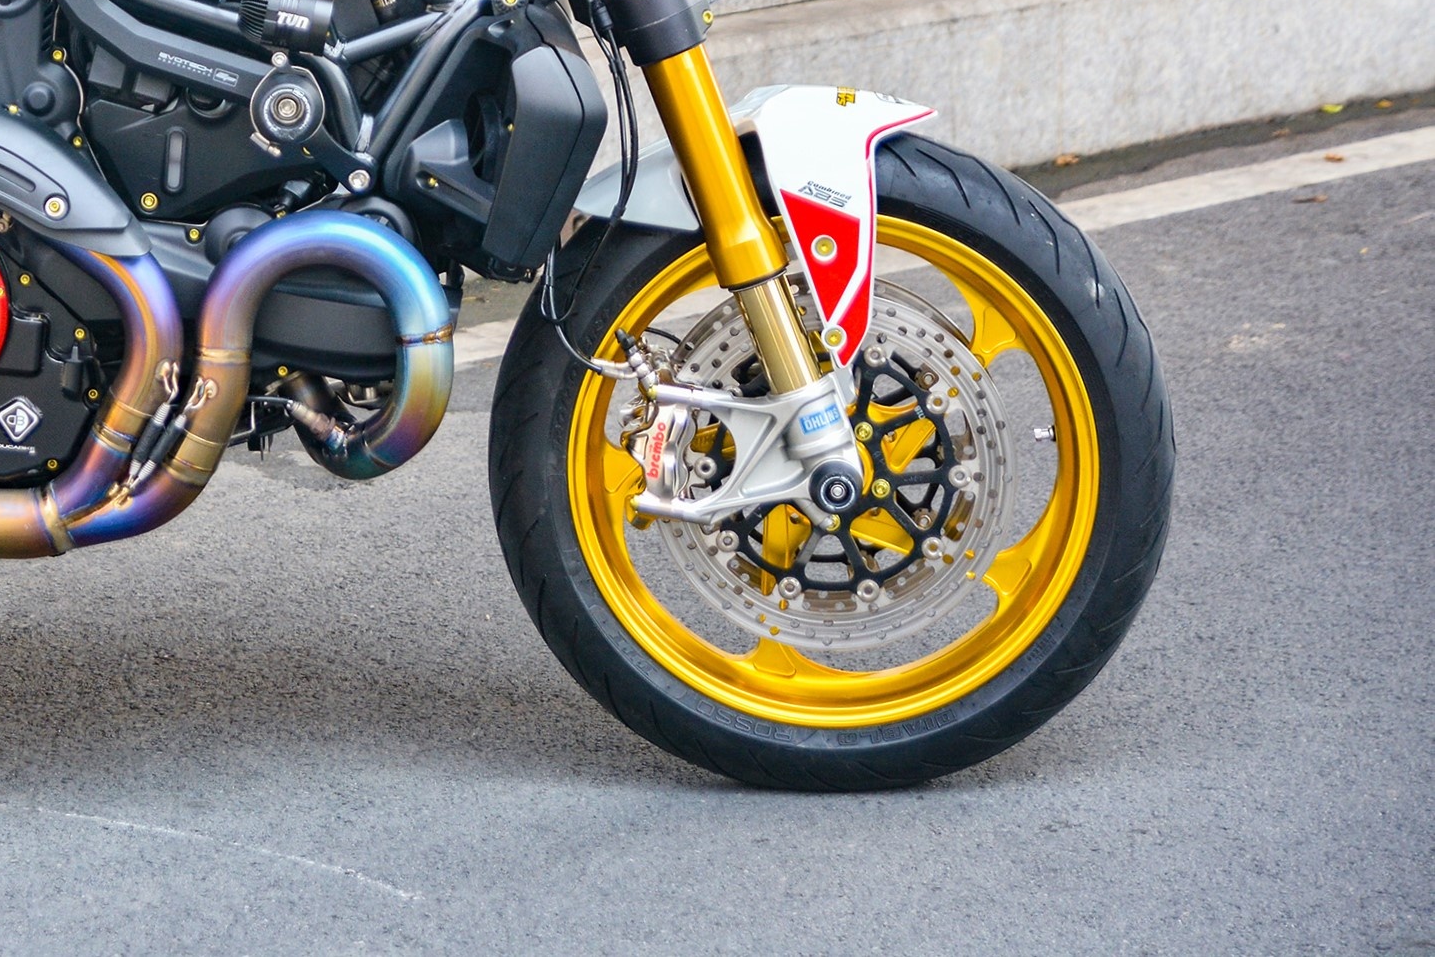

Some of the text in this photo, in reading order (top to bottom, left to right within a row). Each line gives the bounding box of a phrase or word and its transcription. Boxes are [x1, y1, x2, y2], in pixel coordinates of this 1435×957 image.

[798, 185, 848, 208] ABS
[646, 421, 667, 479] brembo
[695, 698, 796, 742] ROSSO
